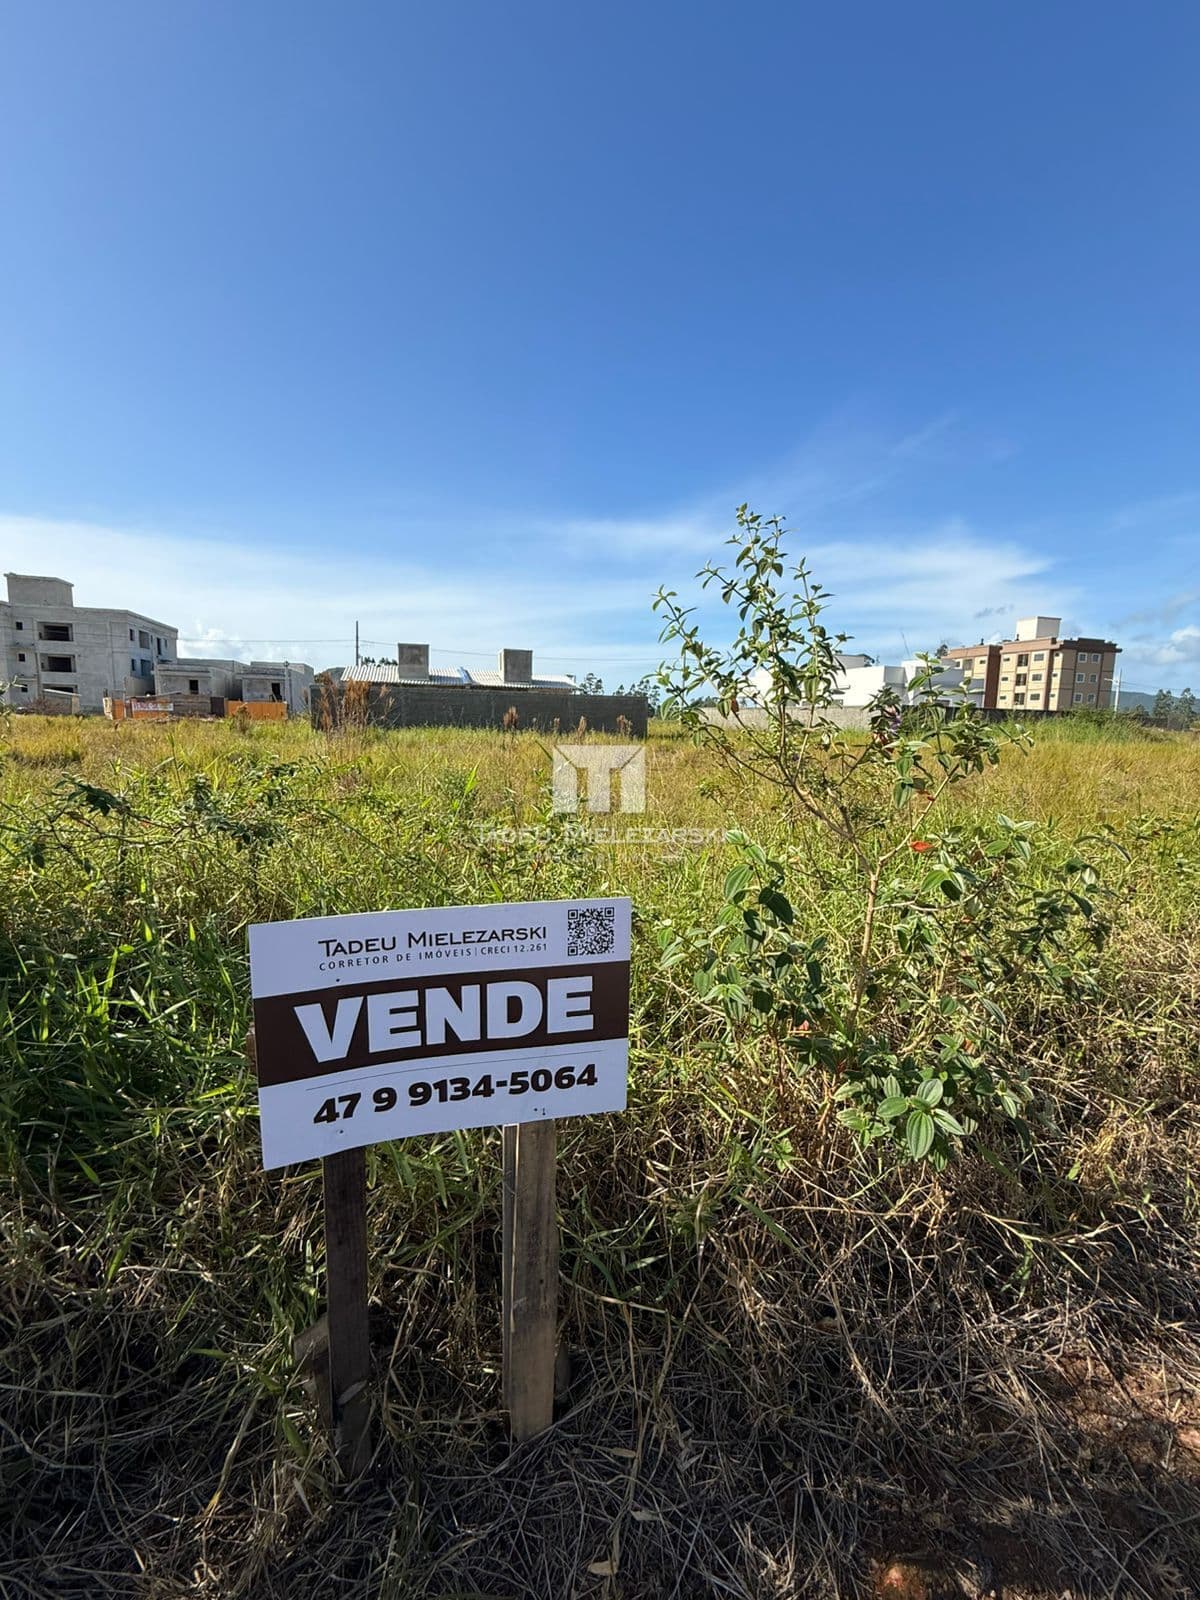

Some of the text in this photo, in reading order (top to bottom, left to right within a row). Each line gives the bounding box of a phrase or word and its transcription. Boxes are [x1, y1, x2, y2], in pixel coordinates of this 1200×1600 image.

[318, 927, 547, 957] TADEU MIELEZARSKI
[319, 943, 547, 971] CORRETOR DE IMÓVEIS CRECI 12.261
[293, 975, 594, 1064] VENDE
[313, 1064, 598, 1124] 47 9 9134-5064
